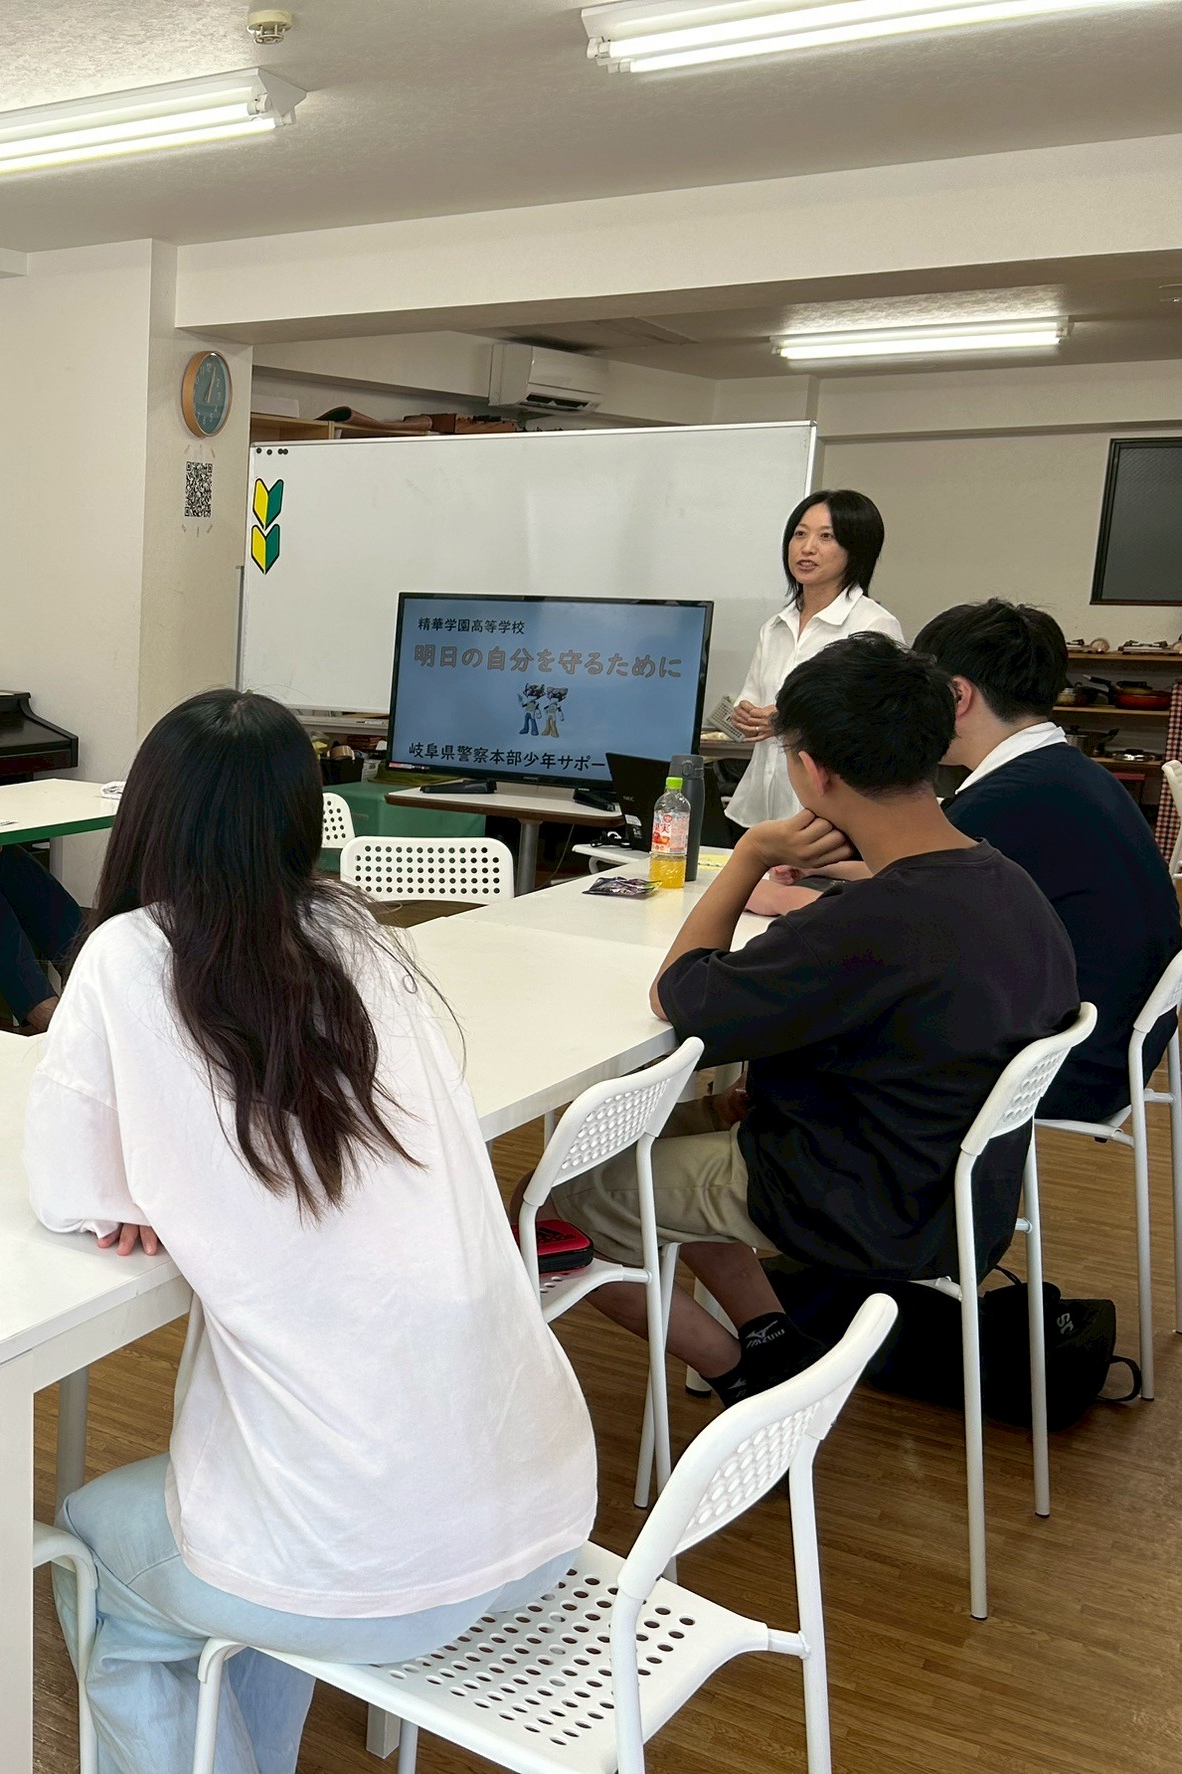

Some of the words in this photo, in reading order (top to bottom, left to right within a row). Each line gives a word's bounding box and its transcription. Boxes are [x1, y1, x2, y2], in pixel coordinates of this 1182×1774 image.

[418, 617, 525, 634] 精華学園高等学校
[414, 644, 682, 679] 明日の自分を守るために
[408, 742, 606, 772] 岐阜県警察本部少年サポー
